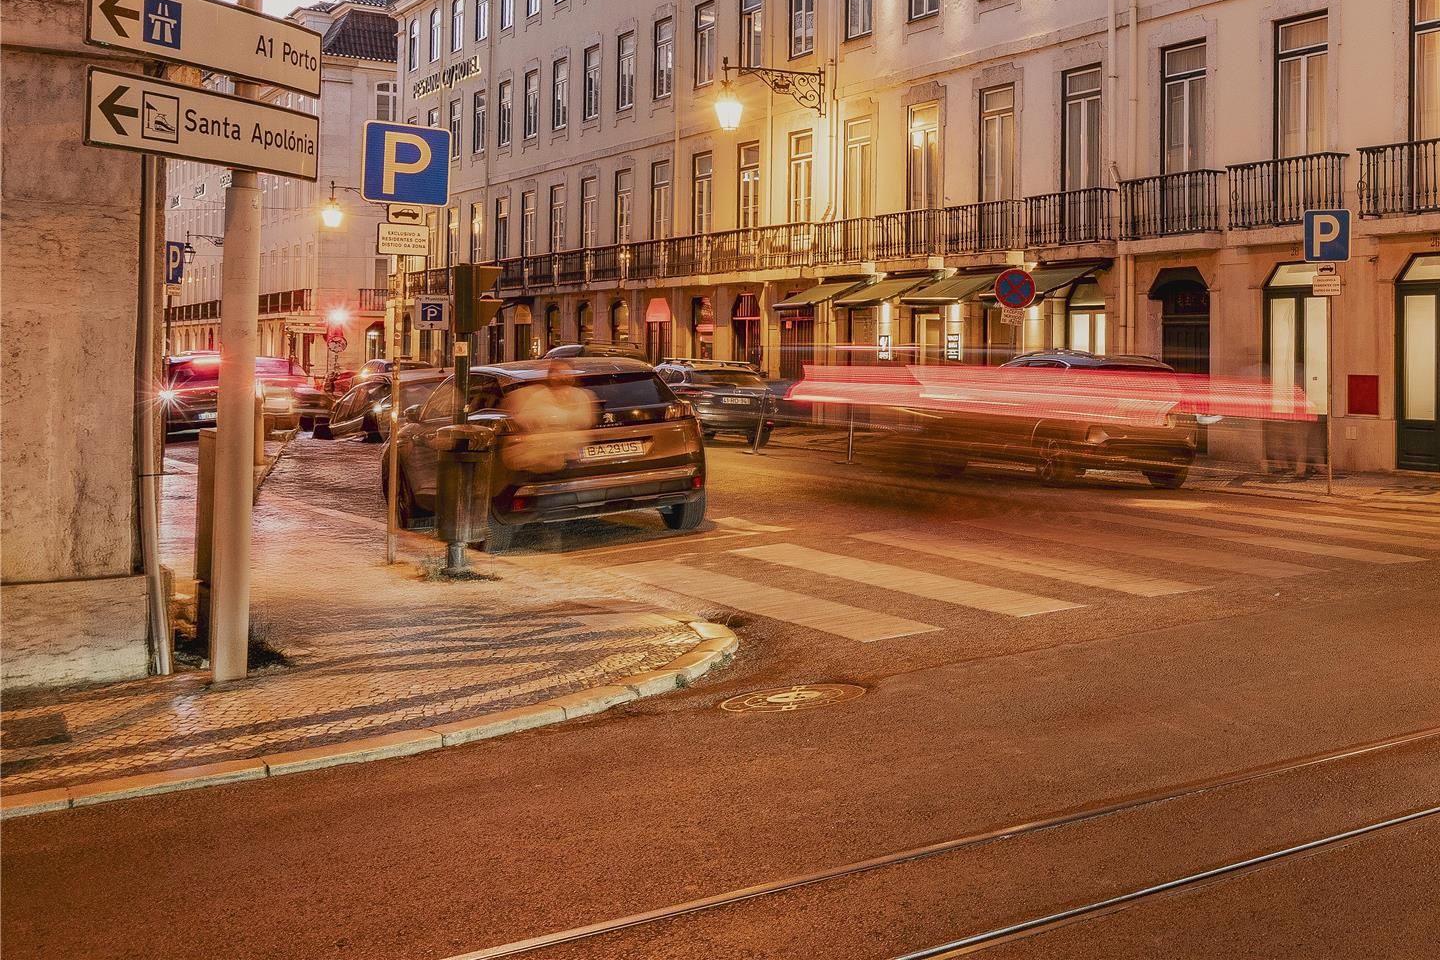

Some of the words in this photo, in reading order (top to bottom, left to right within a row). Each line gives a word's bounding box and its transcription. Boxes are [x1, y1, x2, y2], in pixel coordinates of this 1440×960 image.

[255, 34, 273, 59] A1
[282, 41, 317, 72] Porto
[184, 108, 241, 142] Santa
[251, 122, 314, 156] Apolónia
[382, 130, 432, 195] P
[1312, 214, 1340, 257] P
[169, 245, 181, 281] P
[427, 308, 438, 321] P
[587, 445, 606, 457] BA
[606, 444, 620, 454] 29
